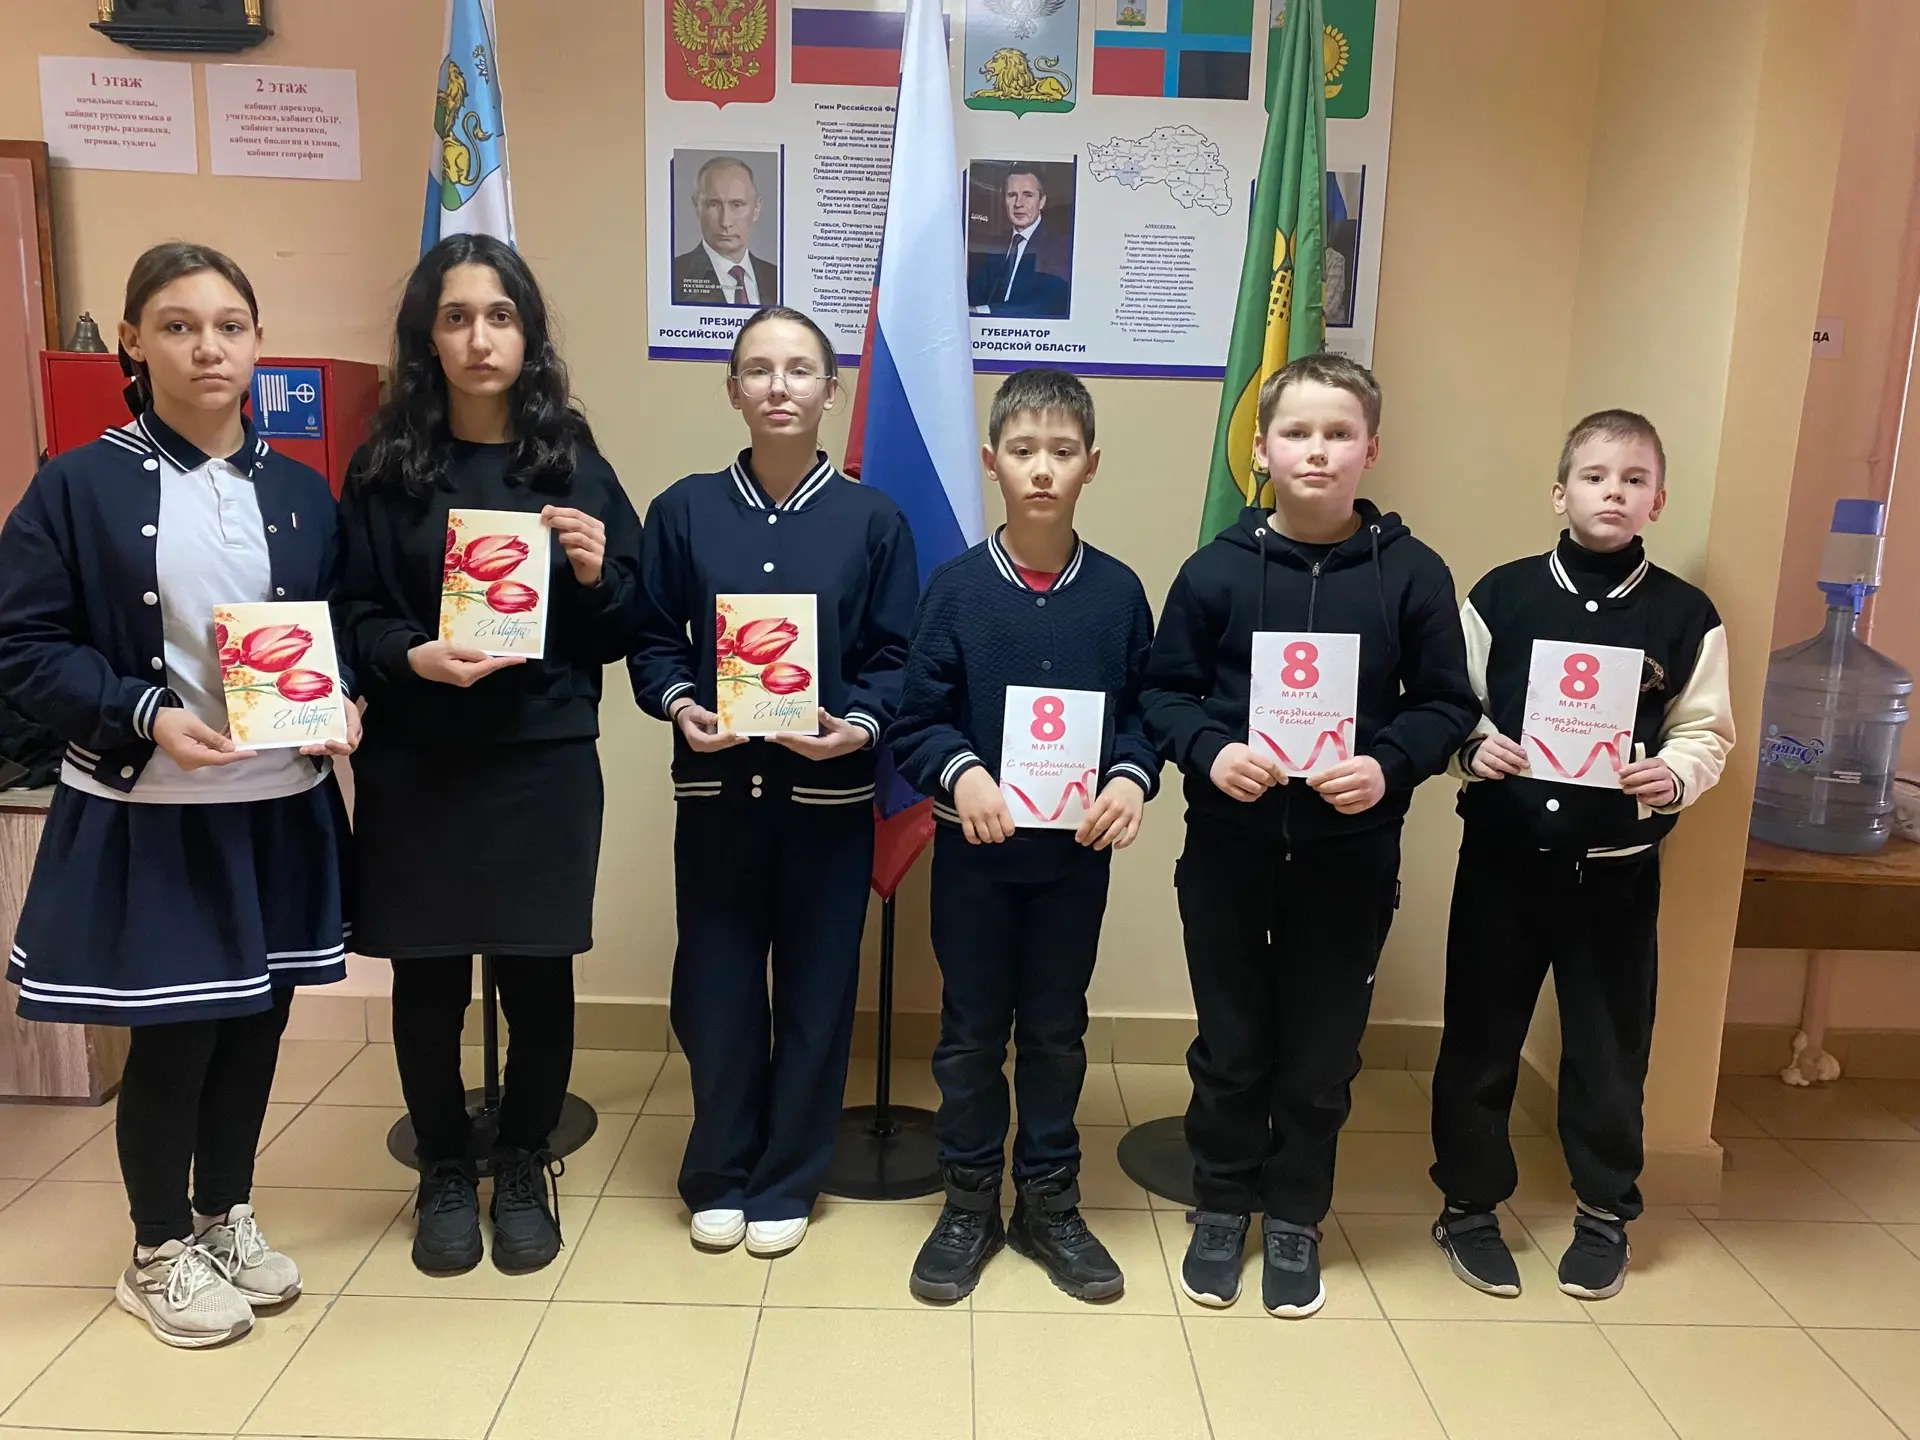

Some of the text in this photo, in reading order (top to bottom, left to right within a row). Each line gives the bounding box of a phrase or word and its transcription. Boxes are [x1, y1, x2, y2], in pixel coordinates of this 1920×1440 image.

[90, 72, 143, 88] 1 этаж
[256, 79, 307, 94] 2 этаж
[77, 96, 158, 108] начальные классы,
[244, 103, 323, 114] кабинет директора,
[837, 104, 882, 112] Российской
[65, 110, 99, 119] кабинет
[100, 113, 137, 121] русского
[225, 113, 279, 122] учительская,
[281, 115, 313, 123] кабинет
[68, 124, 171, 135] литературы, раздевалка,
[240, 124, 327, 135] кабинет математики,
[122, 139, 156, 147] туалеты
[230, 136, 261, 144] кабинет
[264, 137, 302, 145] биологии
[247, 149, 324, 159] кабинет географии
[700, 317, 746, 328] ПРЕЗИД
[660, 329, 734, 339] РОССИЙСКОЙ
[981, 328, 1051, 338] ГУБЕРНАТОР
[971, 341, 1086, 352] ОРОДСКОЙ ОБЛАСТИ
[475, 619, 494, 637] 8
[1281, 641, 1320, 689] 8
[1560, 653, 1600, 700] 8
[1282, 691, 1318, 699] МАРТА
[753, 701, 770, 719] 8
[1559, 700, 1597, 710] МАРТА
[1255, 706, 1342, 717] С праздником
[273, 710, 292, 729] 8
[1030, 695, 1066, 742] 8
[1280, 716, 1316, 725] весны!
[1530, 712, 1619, 730] С праздником
[1555, 724, 1592, 735] весны!
[1006, 759, 1086, 769] С праздником
[1029, 769, 1062, 777] весны!
